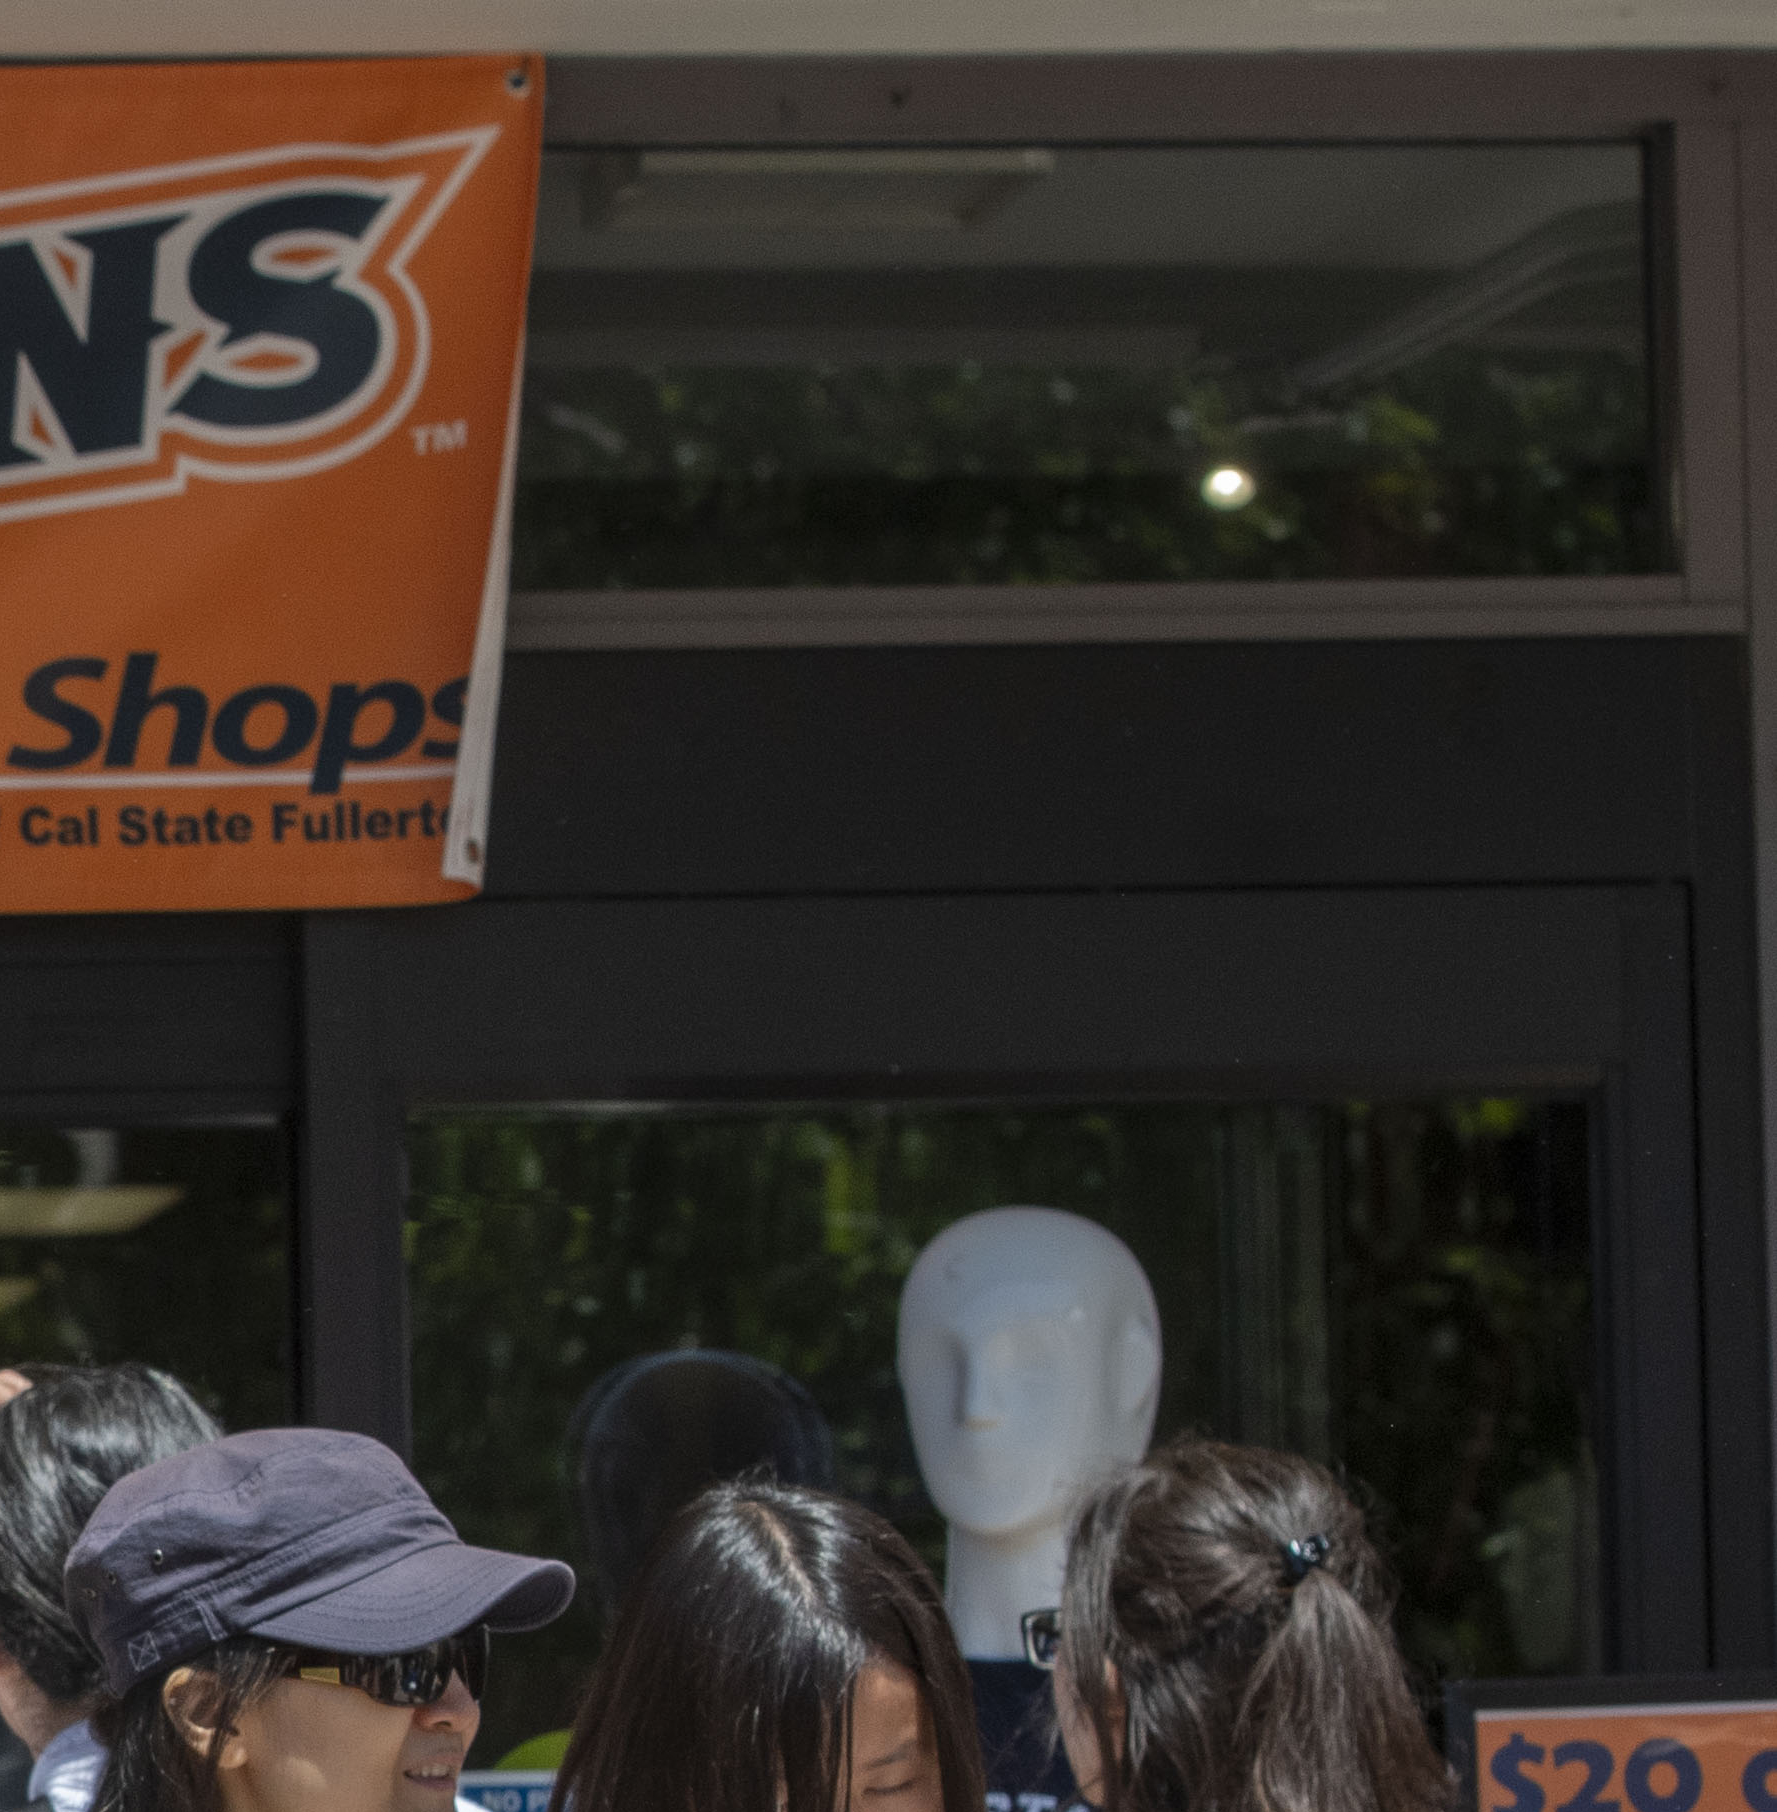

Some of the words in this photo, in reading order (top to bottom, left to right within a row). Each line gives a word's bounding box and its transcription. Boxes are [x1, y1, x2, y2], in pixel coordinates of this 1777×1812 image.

[411, 425, 468, 454] TM
[19, 805, 100, 847] Cal
[118, 804, 254, 847] State
[271, 800, 450, 843] Fullert
